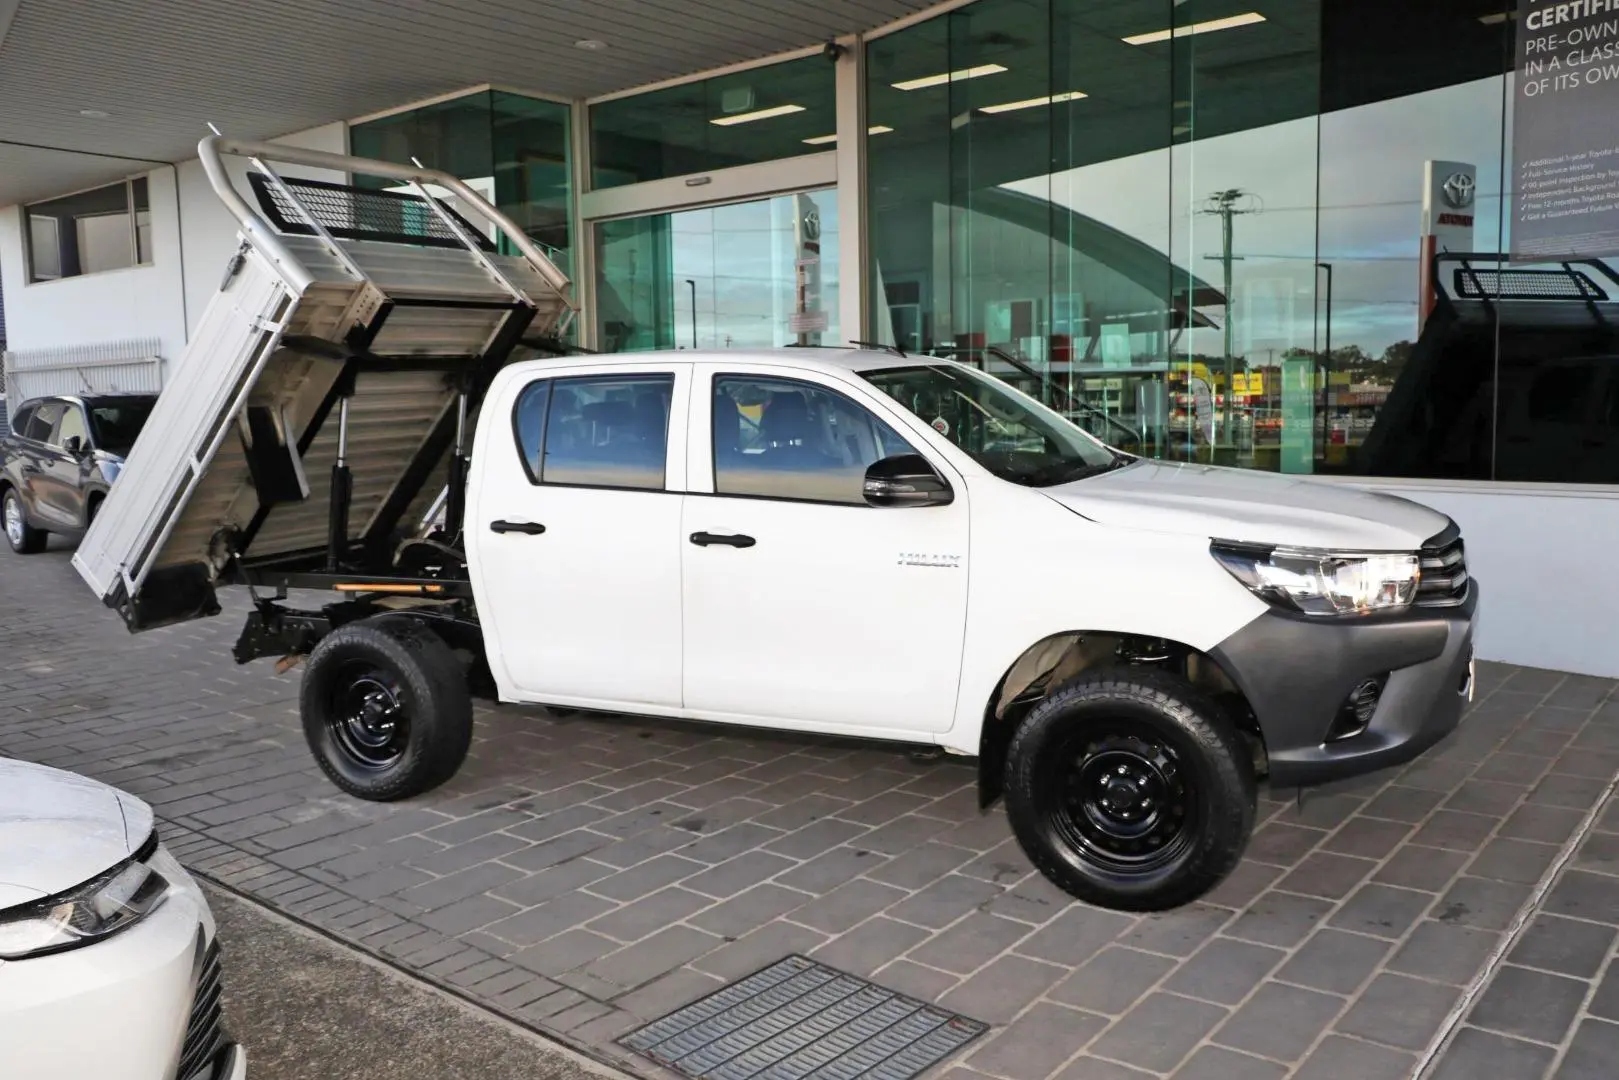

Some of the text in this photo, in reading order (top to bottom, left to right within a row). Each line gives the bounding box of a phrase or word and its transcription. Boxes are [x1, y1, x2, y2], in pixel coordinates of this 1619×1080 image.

[1525, 58, 1543, 77] IN
[1548, 55, 1561, 72] A
[1523, 77, 1549, 97] OF
[1554, 71, 1580, 92] ITS
[1528, 154, 1564, 167] Additional
